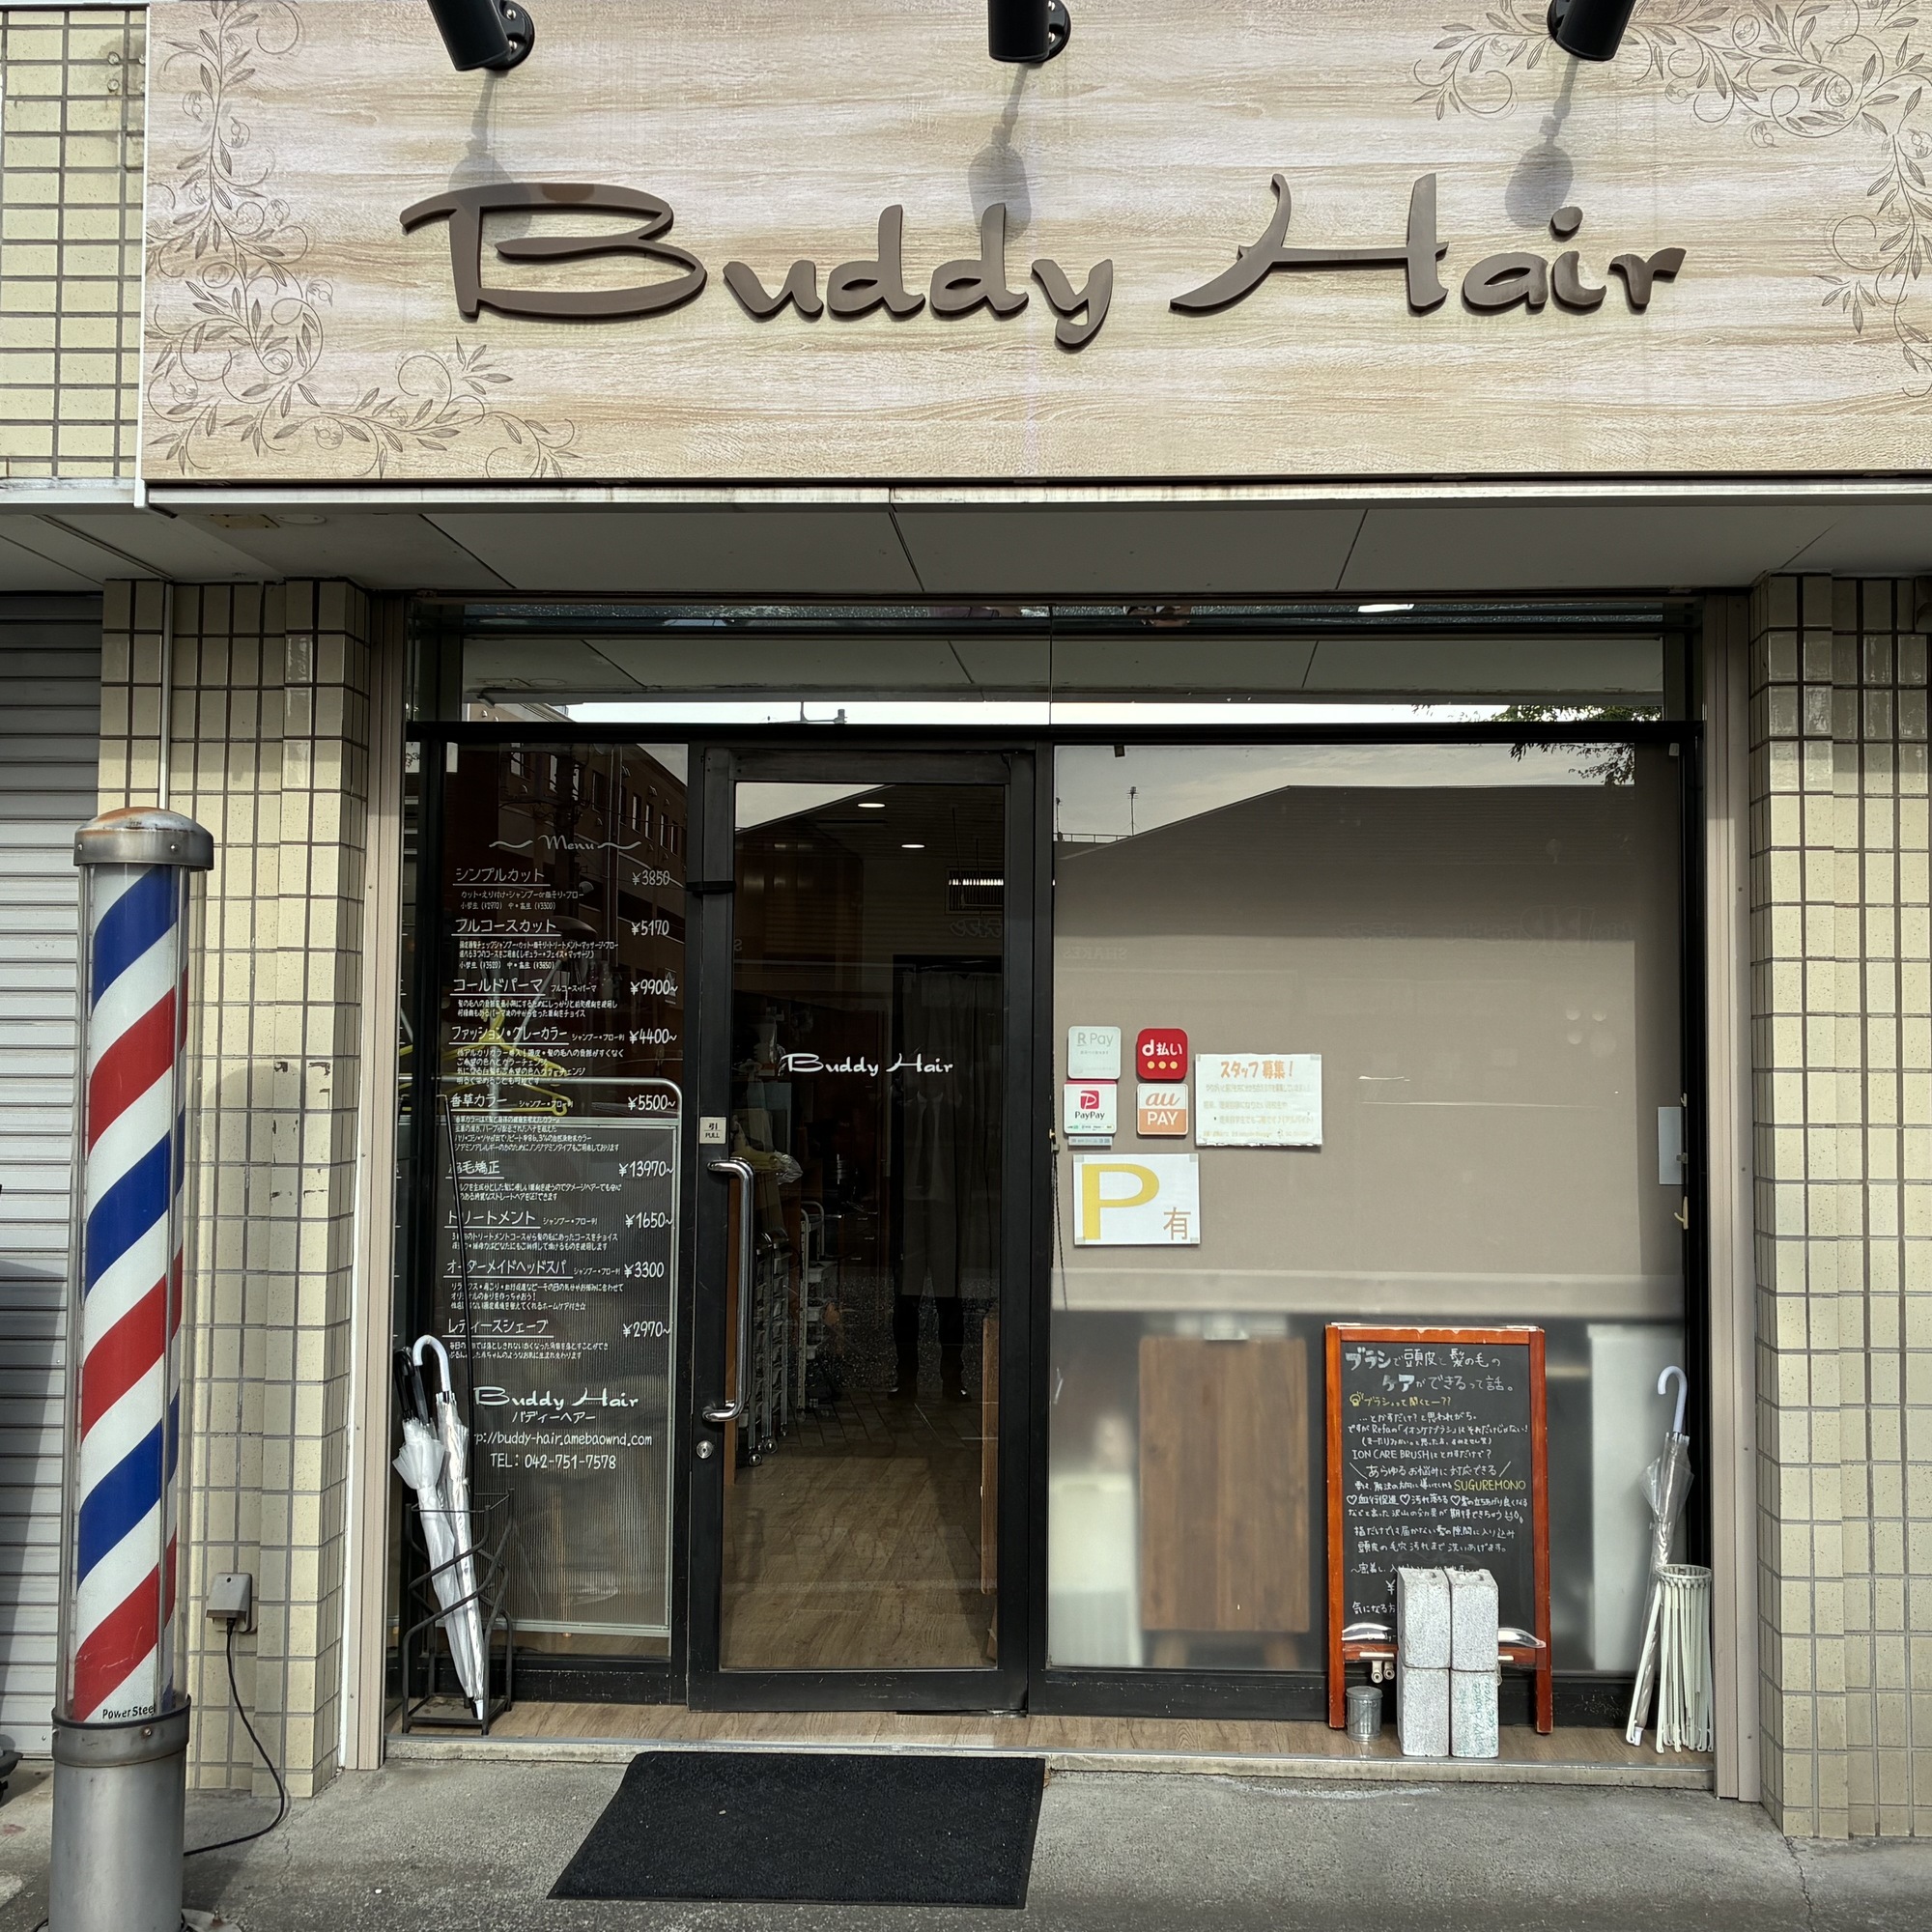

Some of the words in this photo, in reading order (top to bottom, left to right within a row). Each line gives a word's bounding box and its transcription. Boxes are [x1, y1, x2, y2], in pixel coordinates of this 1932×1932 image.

[400, 182, 1114, 350] Buddy
[1169, 173, 1688, 316] Hair
[538, 835, 594, 850] Menu
[456, 868, 544, 882] シンプルカット
[633, 870, 669, 886] ¥3850
[455, 919, 556, 933] フルコースカット
[631, 920, 669, 936] ¥5170
[453, 978, 543, 992] コールドパーマ
[452, 1026, 568, 1041] ファッション・グレーカラー
[1090, 1033, 1114, 1047] Pay
[1142, 1039, 1182, 1057] d払い
[781, 1052, 879, 1076] Buddy
[886, 1053, 953, 1073] Hair
[451, 1094, 507, 1108] 香草カラー
[1145, 1093, 1180, 1107] au
[1074, 1111, 1105, 1121] PayPay
[1147, 1111, 1179, 1125] PAY
[1081, 1163, 1160, 1240] P
[1162, 1207, 1192, 1241] 有
[448, 1210, 536, 1225] トリートメント
[447, 1259, 567, 1274] オーダーメイドヘッドスパ
[624, 1262, 665, 1278] ¥3300
[448, 1319, 549, 1334] レディースシェーブ
[473, 1386, 564, 1410] Buddy
[572, 1387, 639, 1407] Hair
[512, 1411, 596, 1424] バディーヘアー
[474, 1432, 652, 1446] p://buddy-hair.amebaownd.com
[491, 1453, 519, 1468] TEL:
[525, 1455, 616, 1469] 042-751-7578
[1352, 1450, 1372, 1460] ION
[1373, 1450, 1398, 1460] CARE
[1454, 1480, 1526, 1492] SUGUREMONO
[1358, 1494, 1399, 1504] 血行促進
[1411, 1493, 1448, 1504] 汚れ落ちる
[1352, 1602, 1395, 1614] 気になる方
